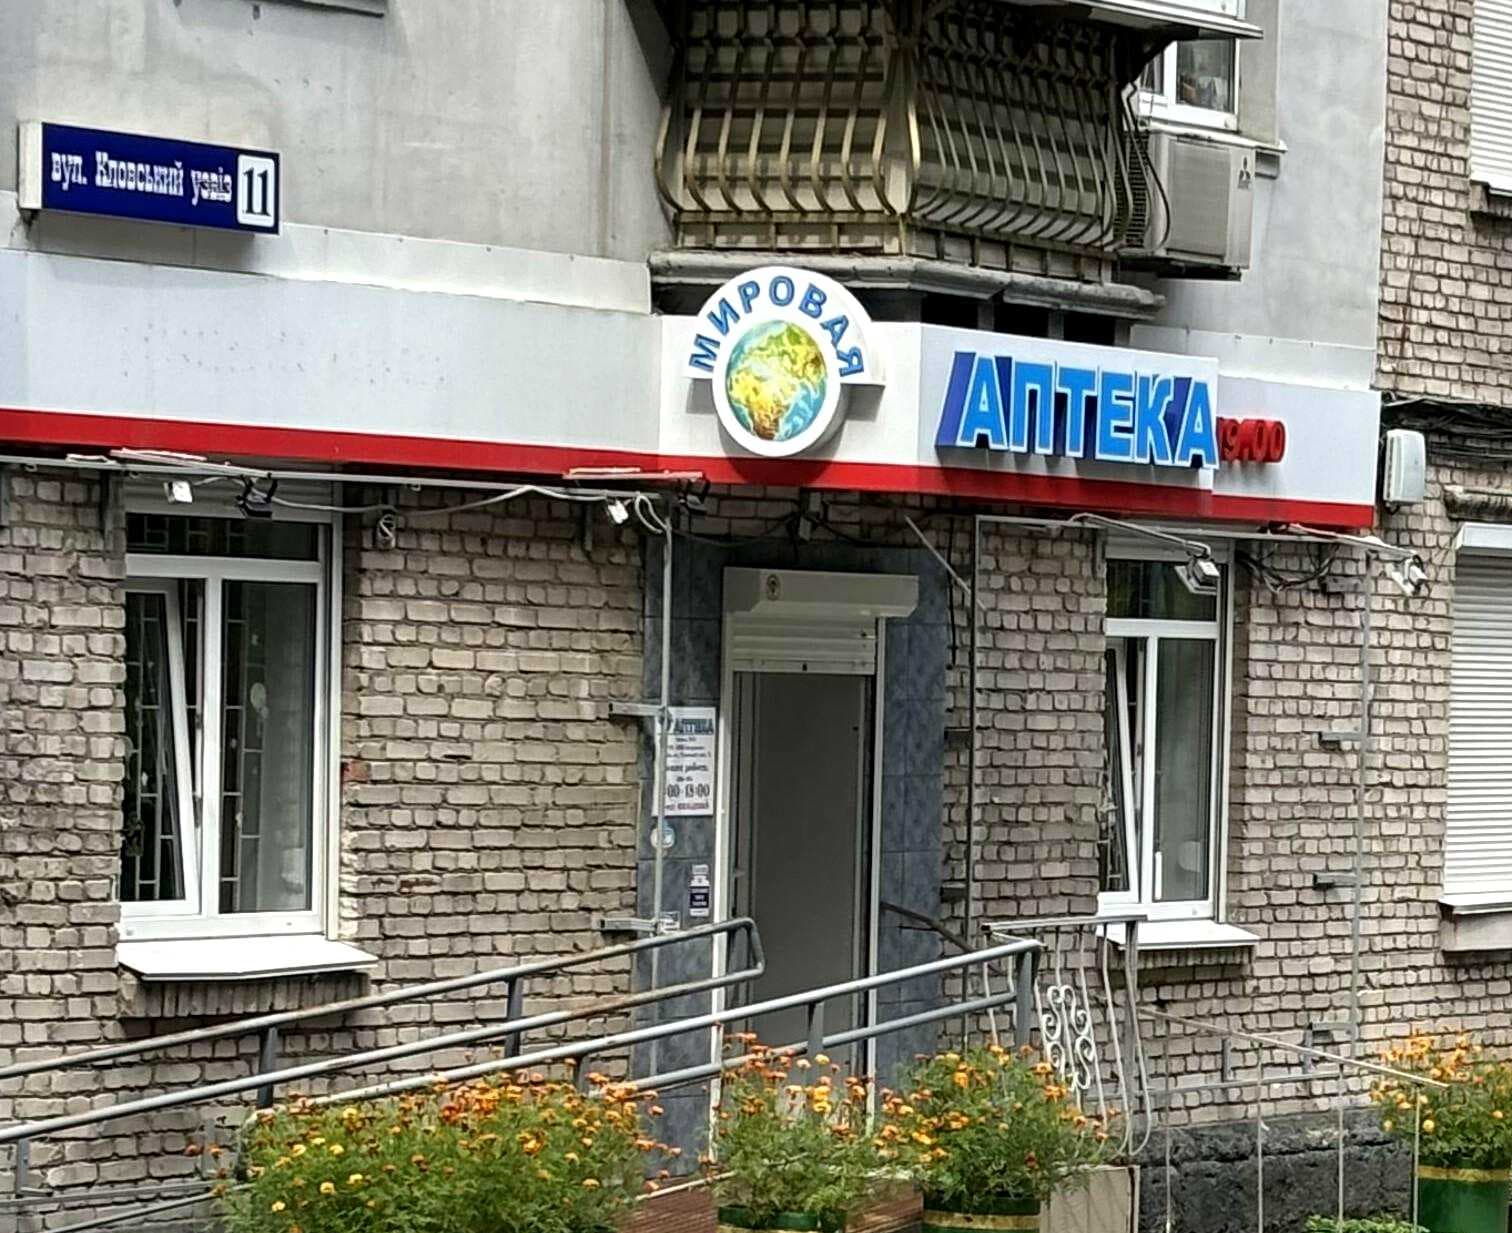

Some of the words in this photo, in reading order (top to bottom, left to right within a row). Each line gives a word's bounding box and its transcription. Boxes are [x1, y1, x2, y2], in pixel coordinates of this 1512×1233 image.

[51, 151, 88, 190] вул.
[95, 150, 184, 197] Кловський
[242, 166, 271, 217] 11
[688, 275, 865, 378] МИРОВАЯ
[937, 351, 1219, 469] АПТЕКА
